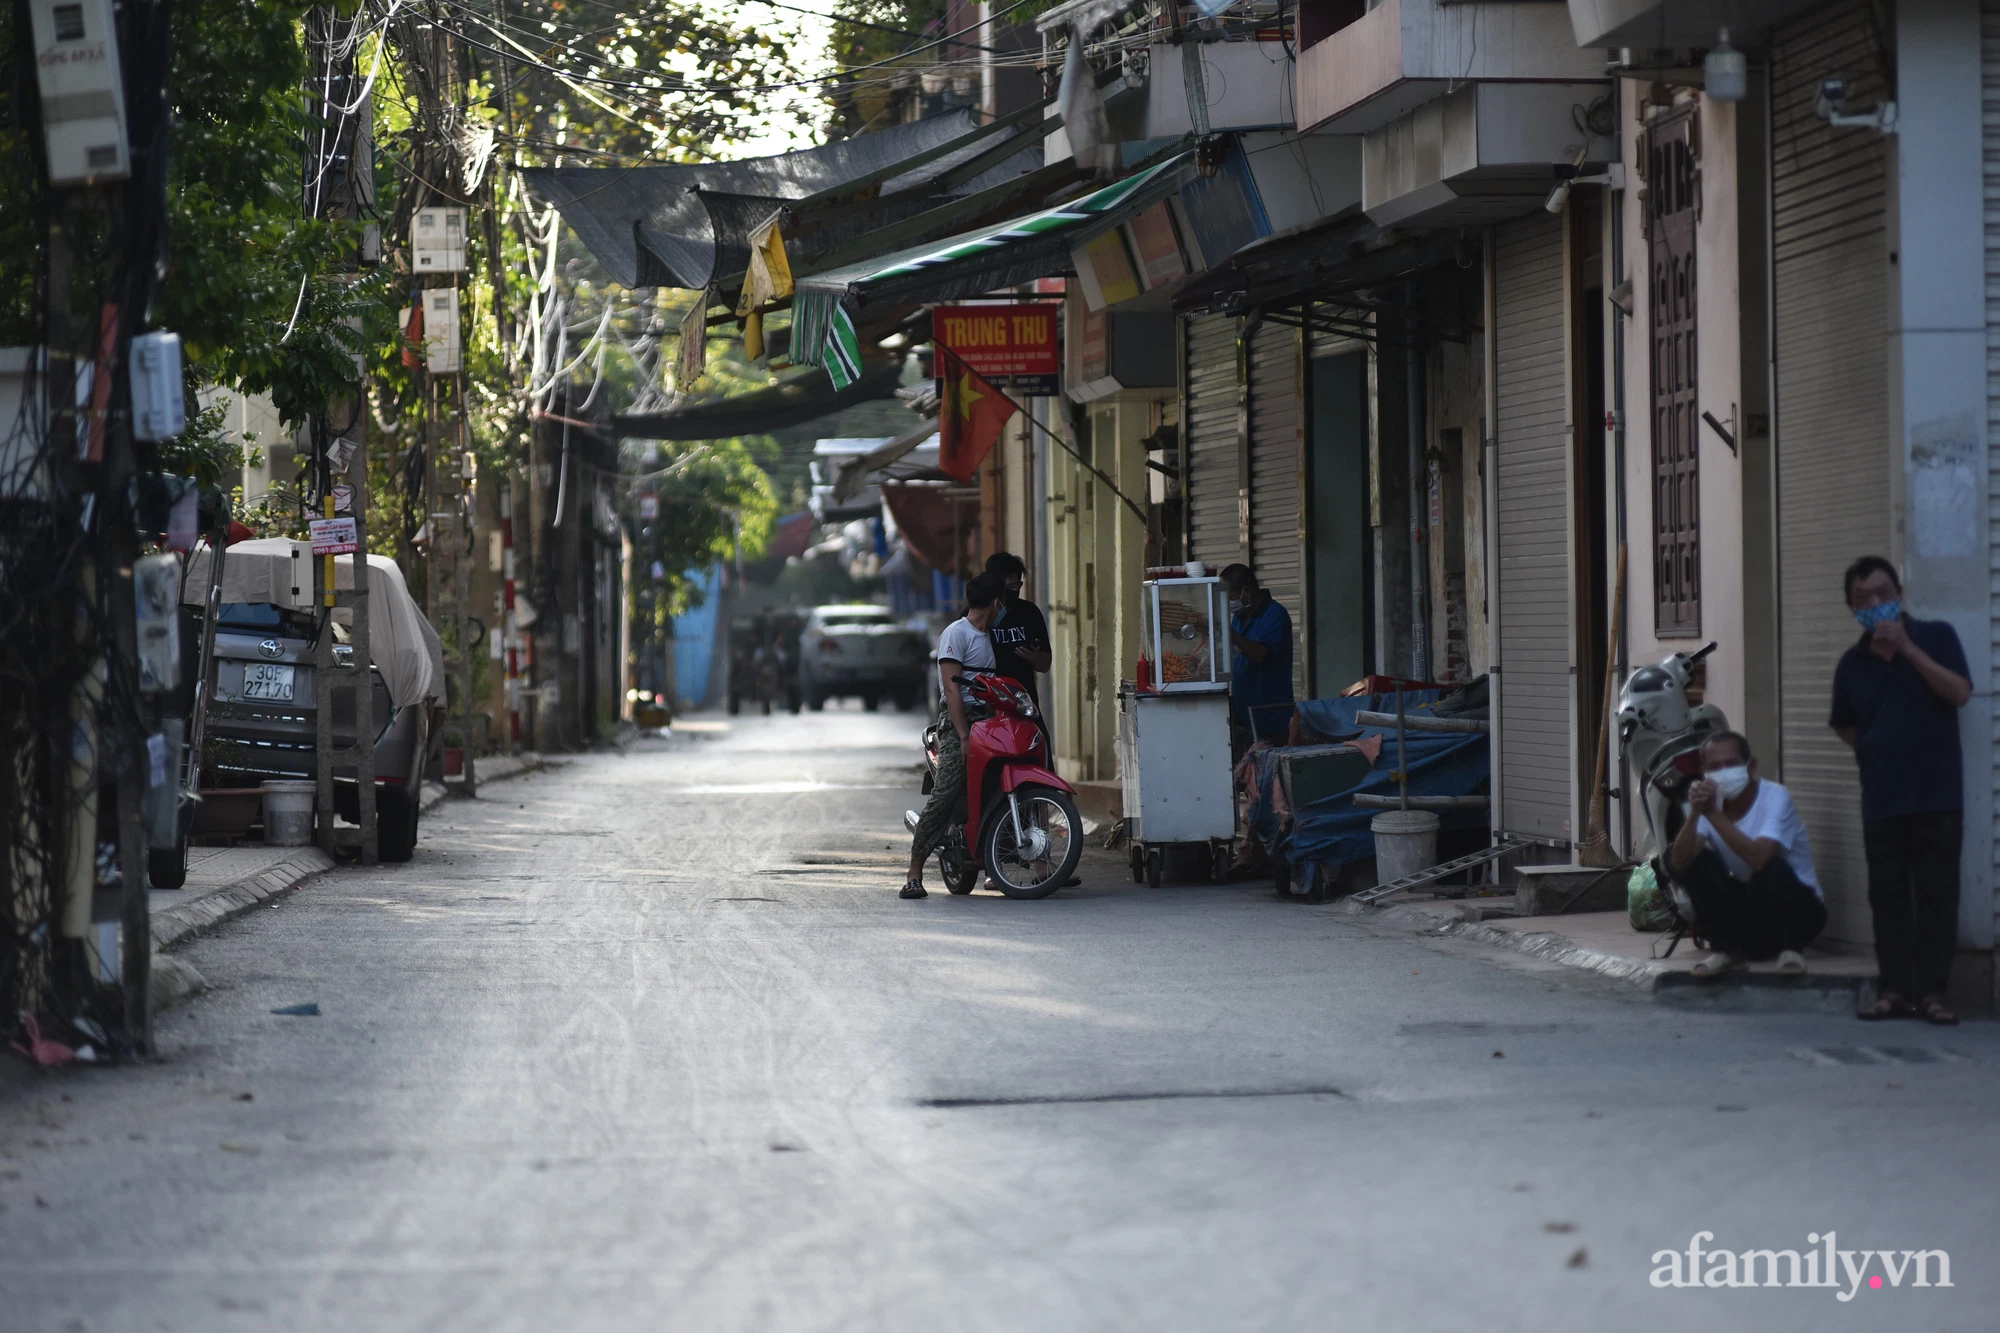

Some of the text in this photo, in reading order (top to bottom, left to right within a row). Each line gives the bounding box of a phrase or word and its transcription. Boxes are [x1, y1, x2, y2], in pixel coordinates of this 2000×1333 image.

[944, 315, 1048, 347] TRUNG THU
[992, 626, 1027, 644] VLTN
[256, 665, 283, 680] 30F
[245, 681, 292, 698] 271.70
